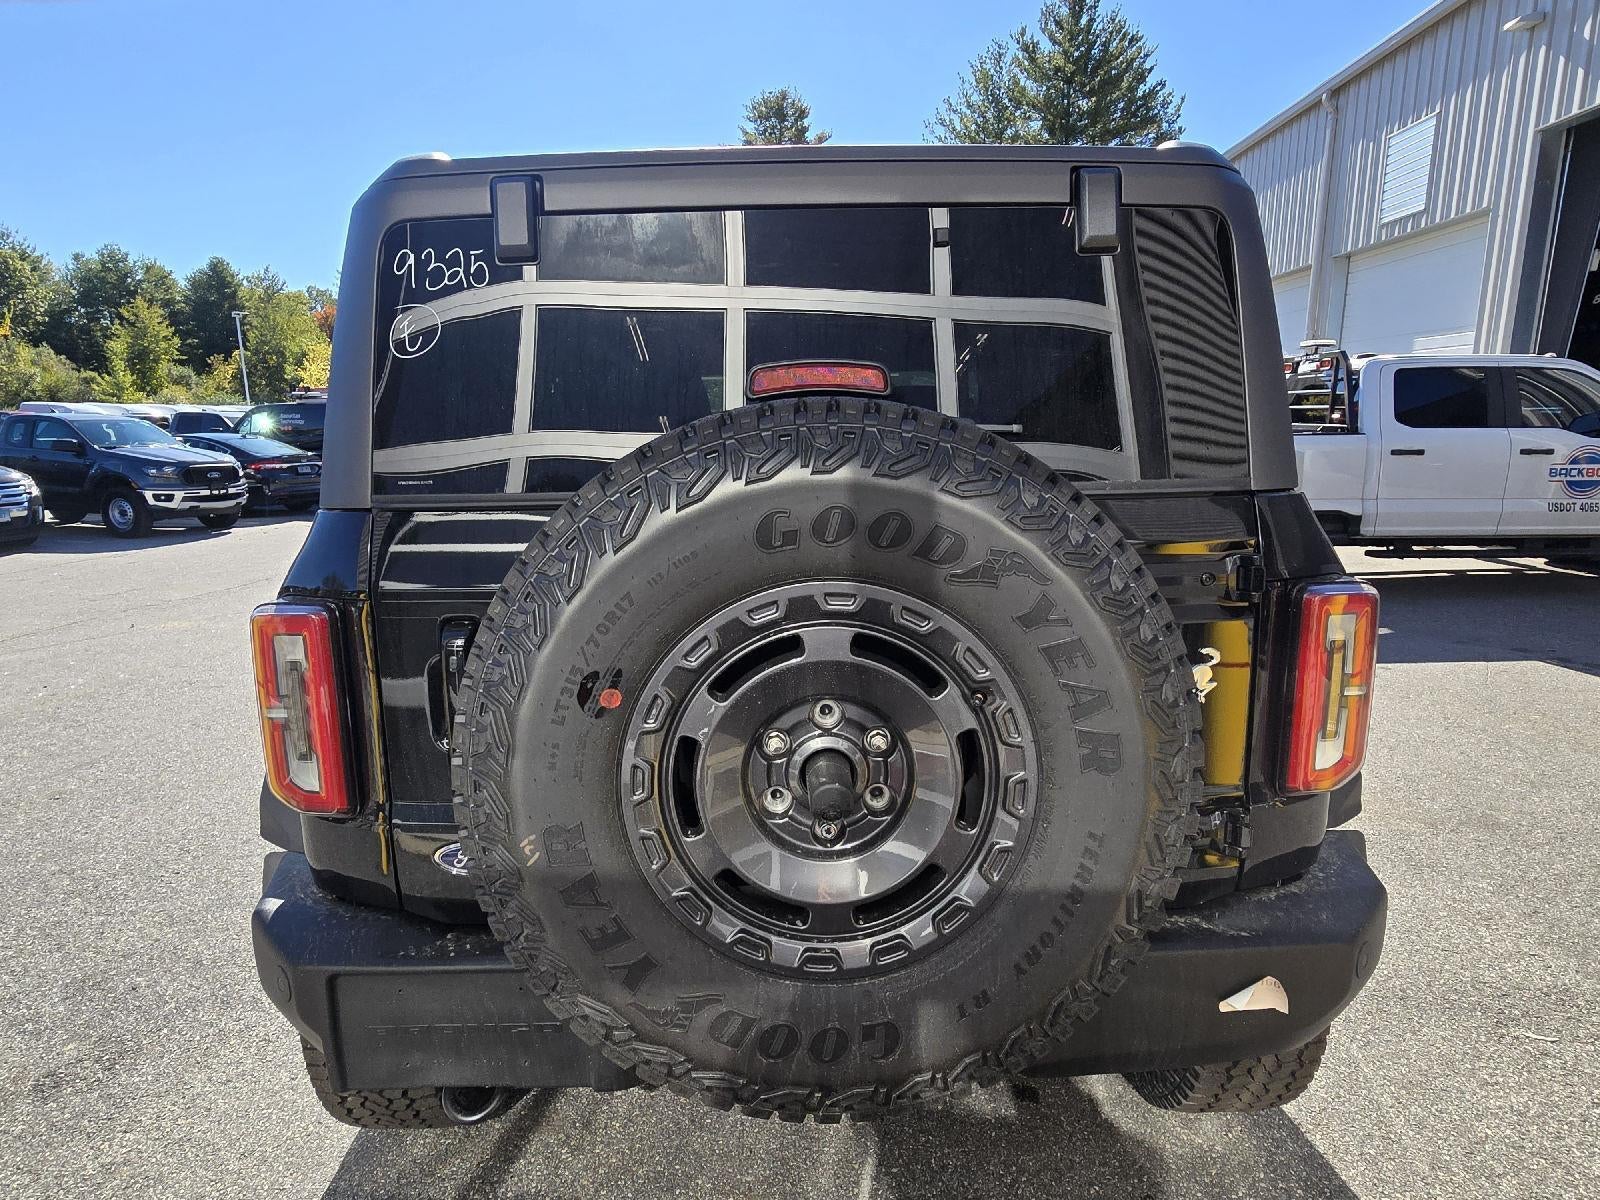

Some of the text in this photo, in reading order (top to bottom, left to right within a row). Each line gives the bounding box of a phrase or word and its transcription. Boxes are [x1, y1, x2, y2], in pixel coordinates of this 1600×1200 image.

[393, 247, 490, 291] 9325
[1547, 502, 1600, 513] USDOT 4065
